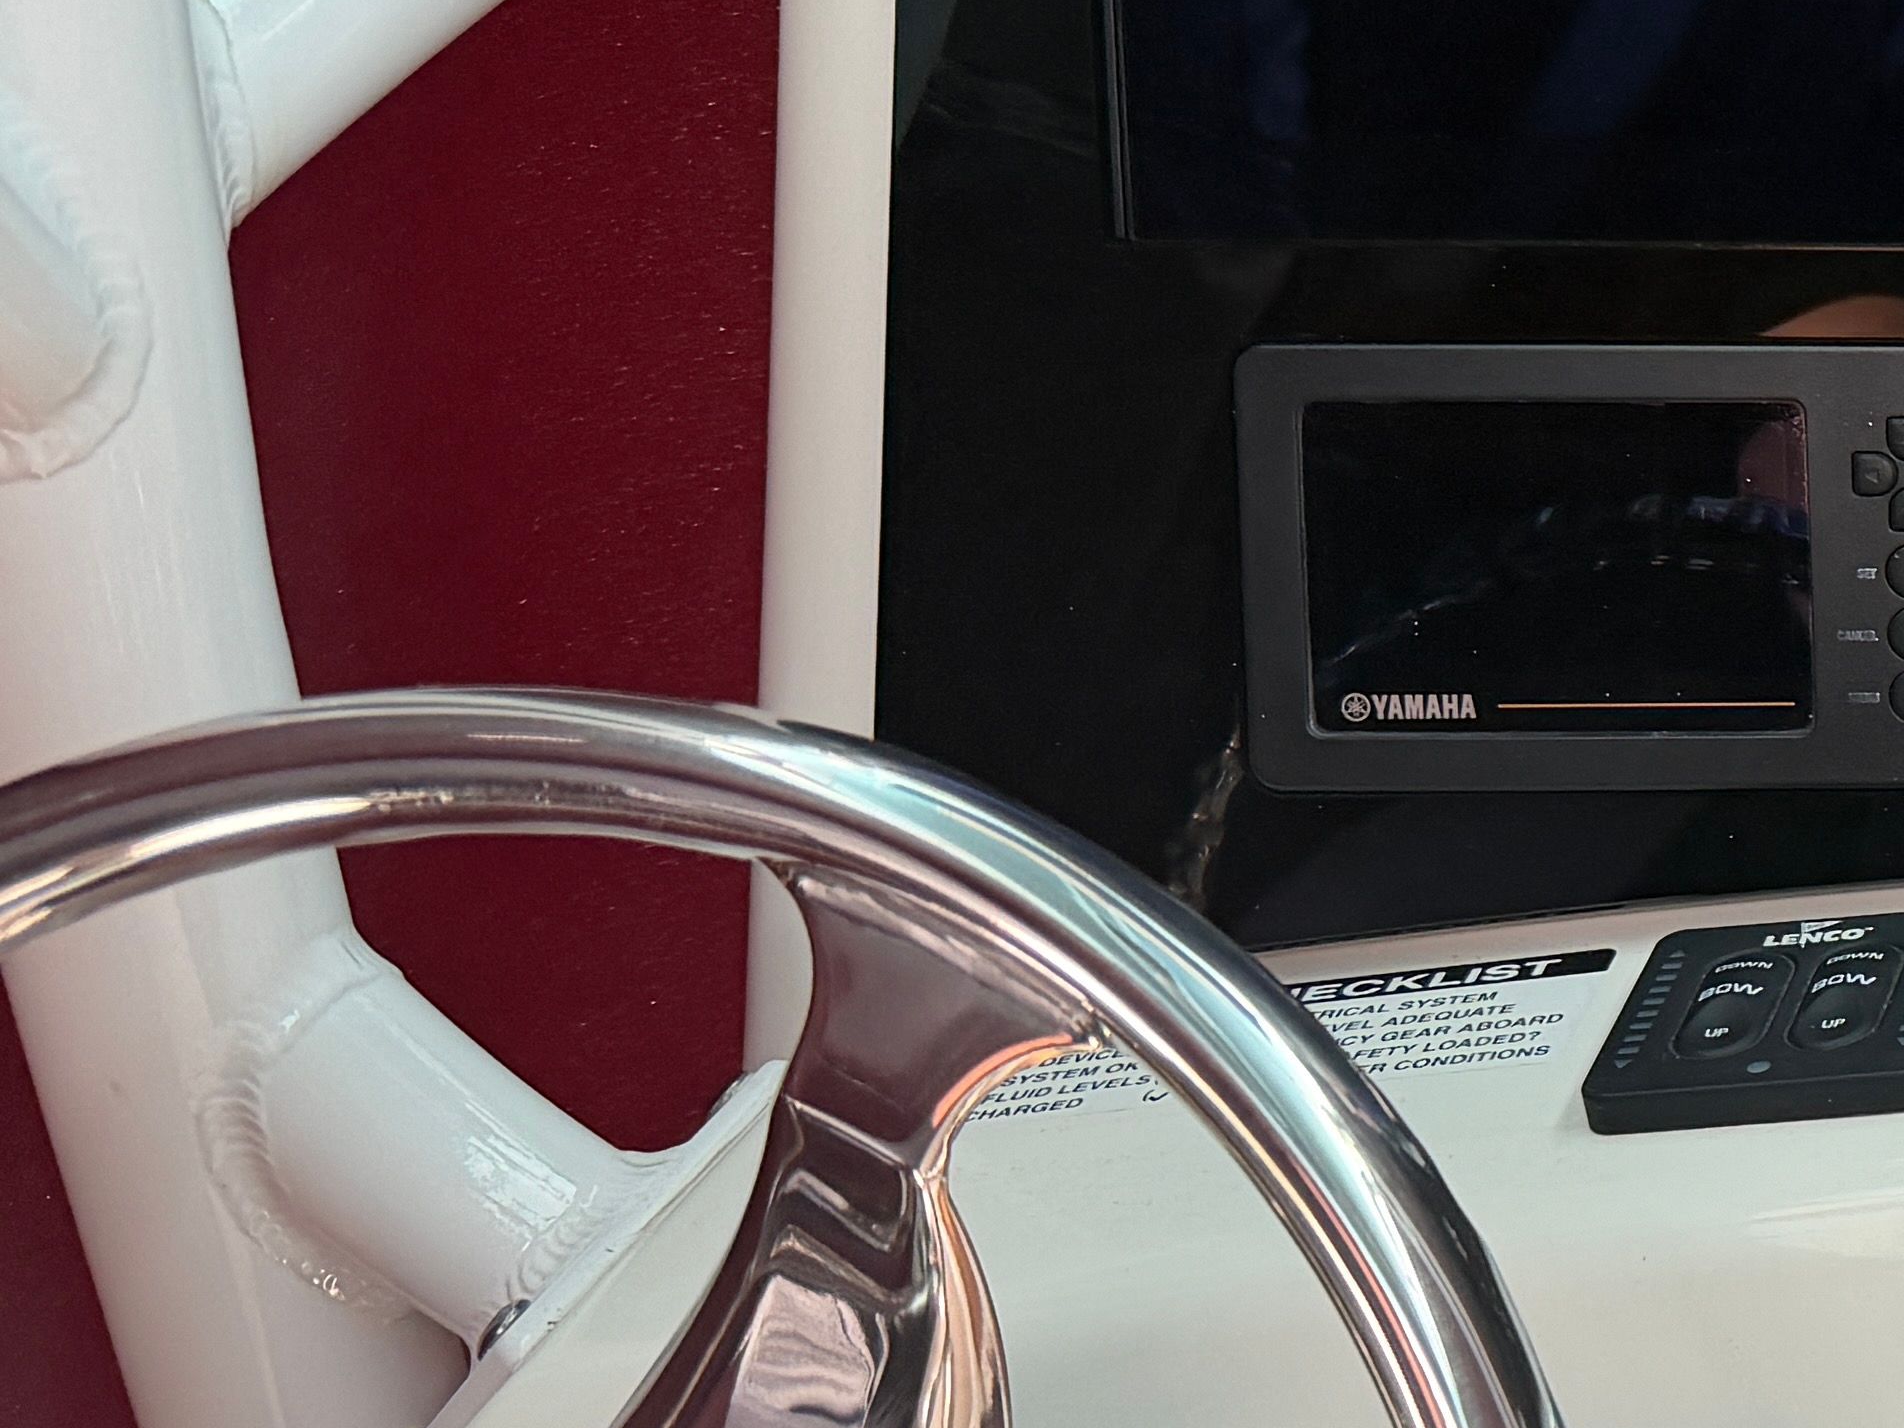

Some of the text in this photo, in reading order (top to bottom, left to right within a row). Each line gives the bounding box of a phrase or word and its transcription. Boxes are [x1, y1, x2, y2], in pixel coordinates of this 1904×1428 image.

[1371, 694, 1477, 720] YAMAHA
[1762, 928, 1865, 947] LENCO
[1290, 959, 1563, 1002] ECKLIST
[1698, 982, 1764, 1002] BOW
[1811, 972, 1877, 994] BOW
[1311, 991, 1499, 1020] RICAL SYSTEM
[1380, 1004, 1517, 1028] ADEQUATE
[1381, 1025, 1452, 1043] GEAR
[1460, 1013, 1565, 1035] ABOARD
[1704, 1027, 1729, 1038] UP
[1821, 1018, 1846, 1029] UP
[1422, 1031, 1542, 1053] LOADED?
[1394, 1045, 1551, 1071] CONDITIONS
[981, 1074, 1152, 1104] FLUID LEVELS
[967, 1097, 1084, 1122] CHARGED
